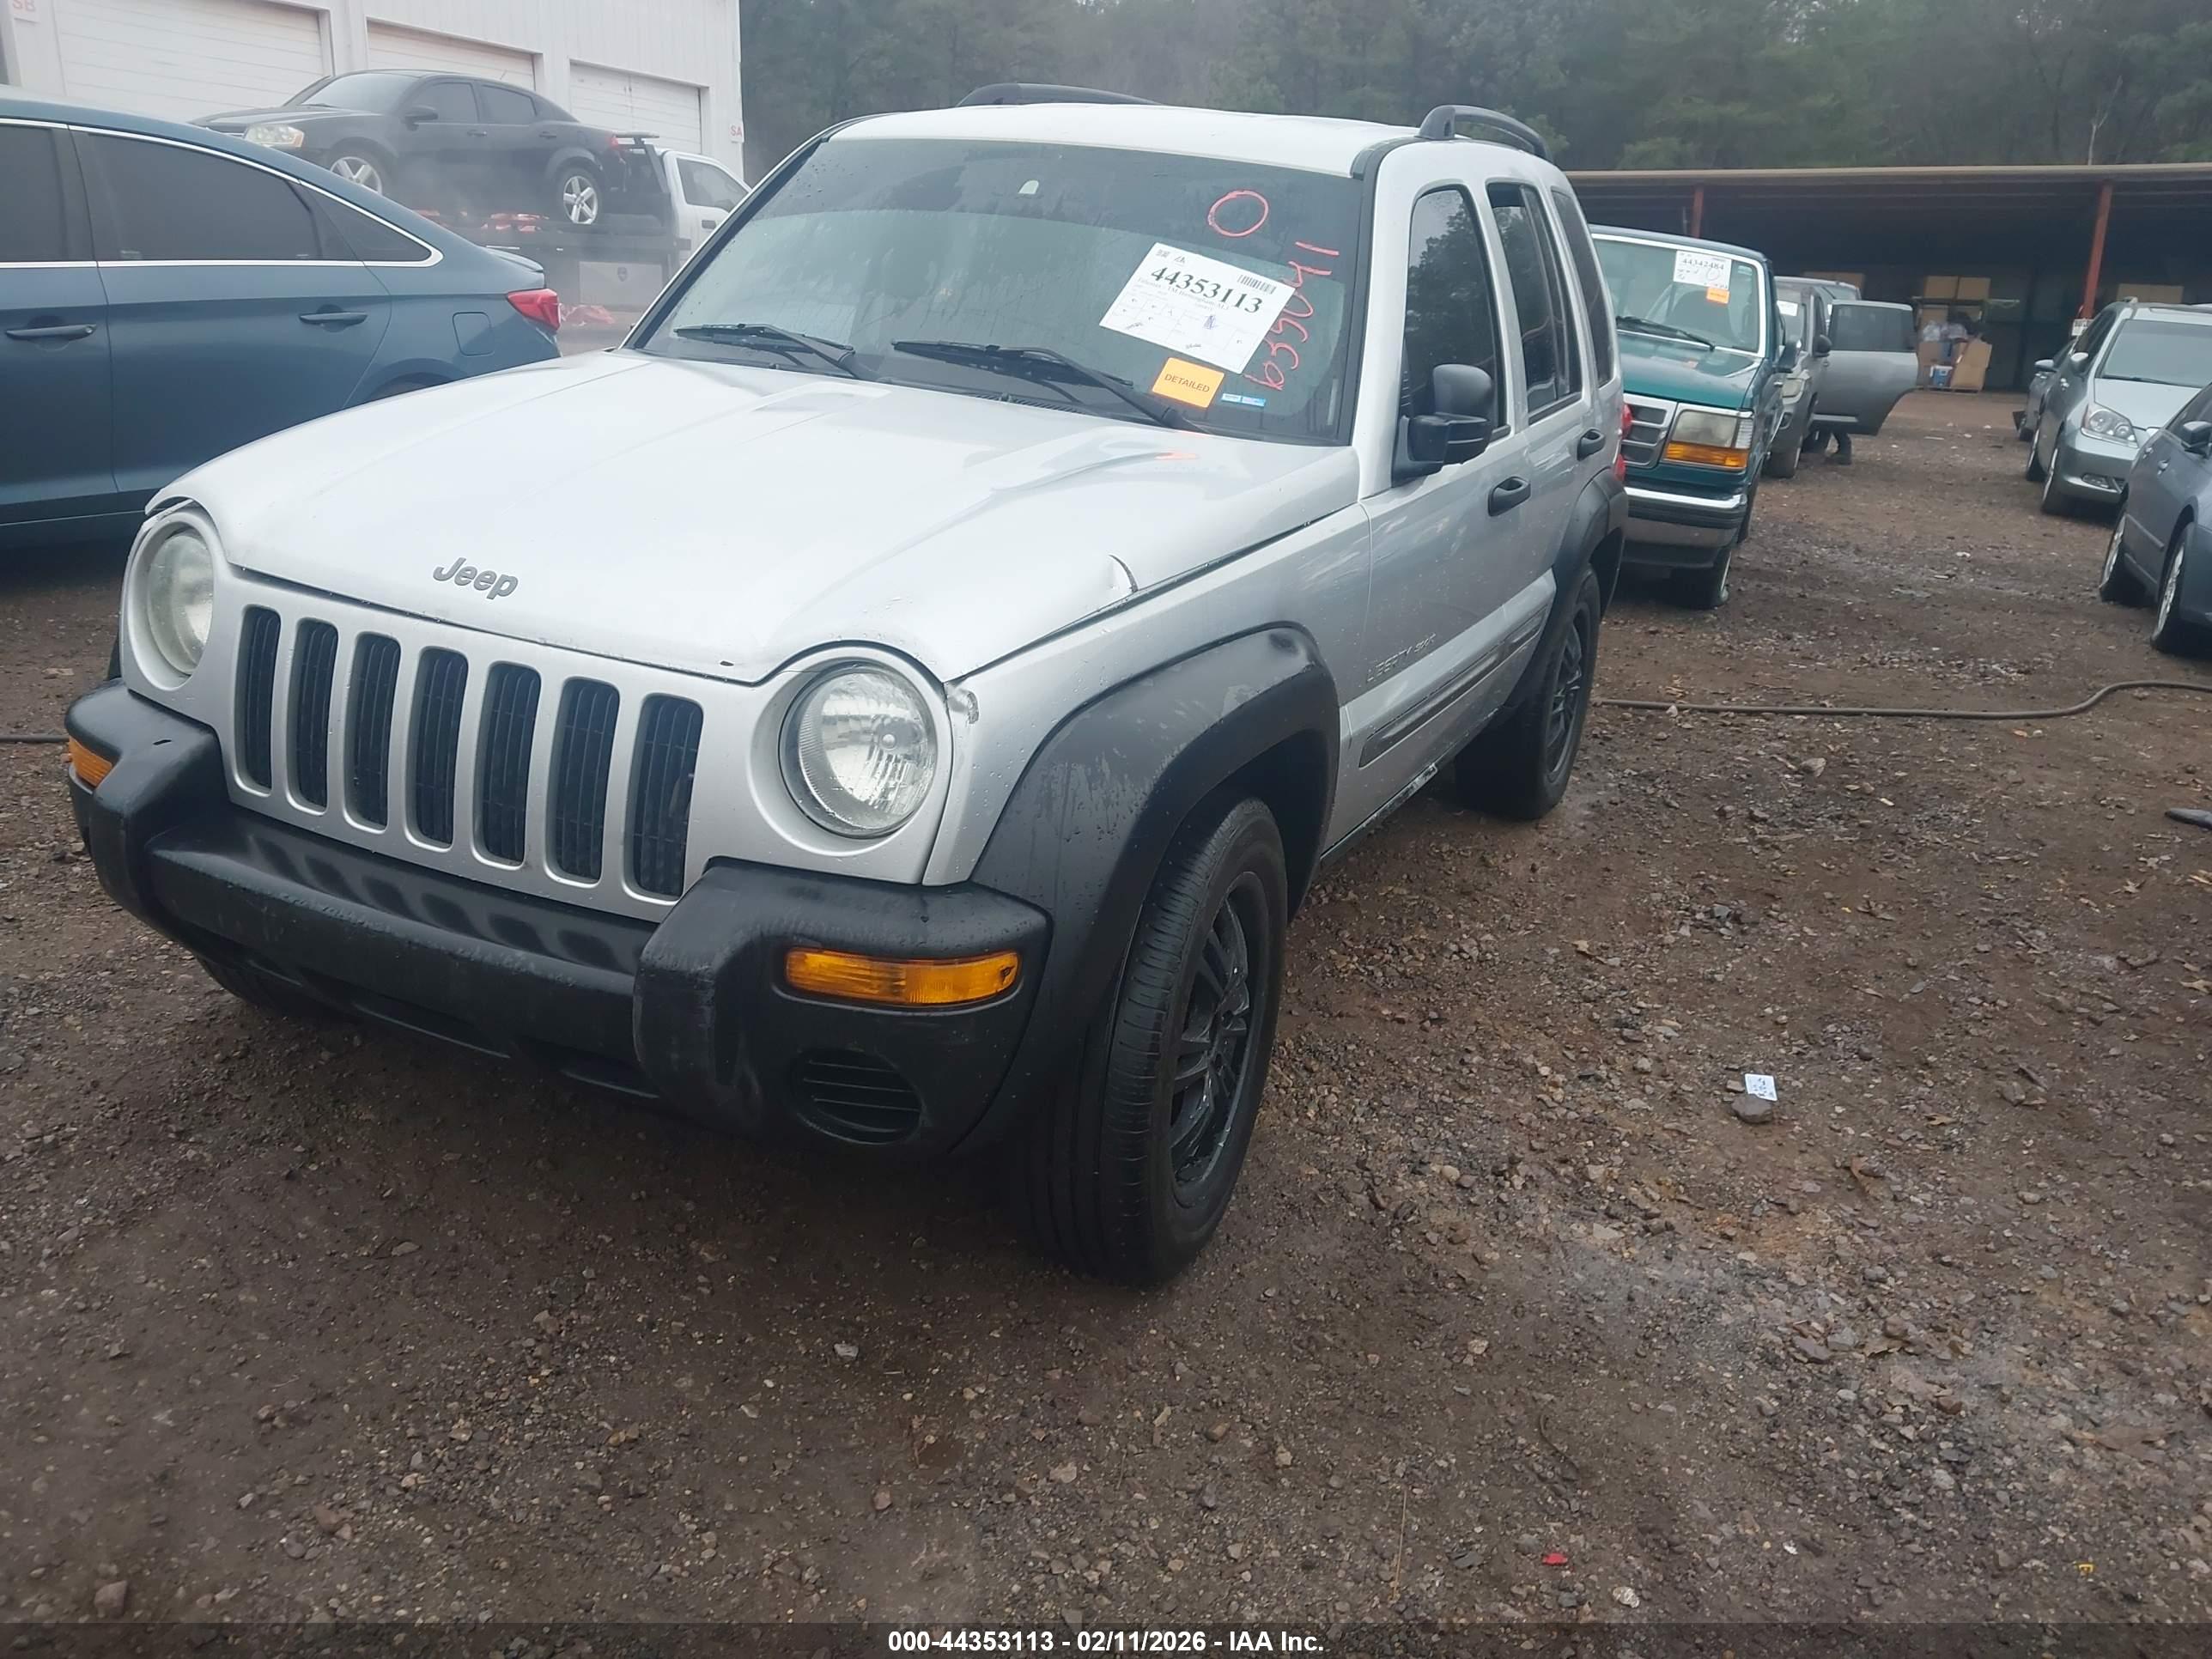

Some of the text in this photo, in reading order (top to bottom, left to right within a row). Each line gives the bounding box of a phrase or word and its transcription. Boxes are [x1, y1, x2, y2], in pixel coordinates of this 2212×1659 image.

[1151, 266, 1263, 313] 44353113
[1164, 373, 1210, 392] DETAILED
[432, 556, 520, 600] Jeep
